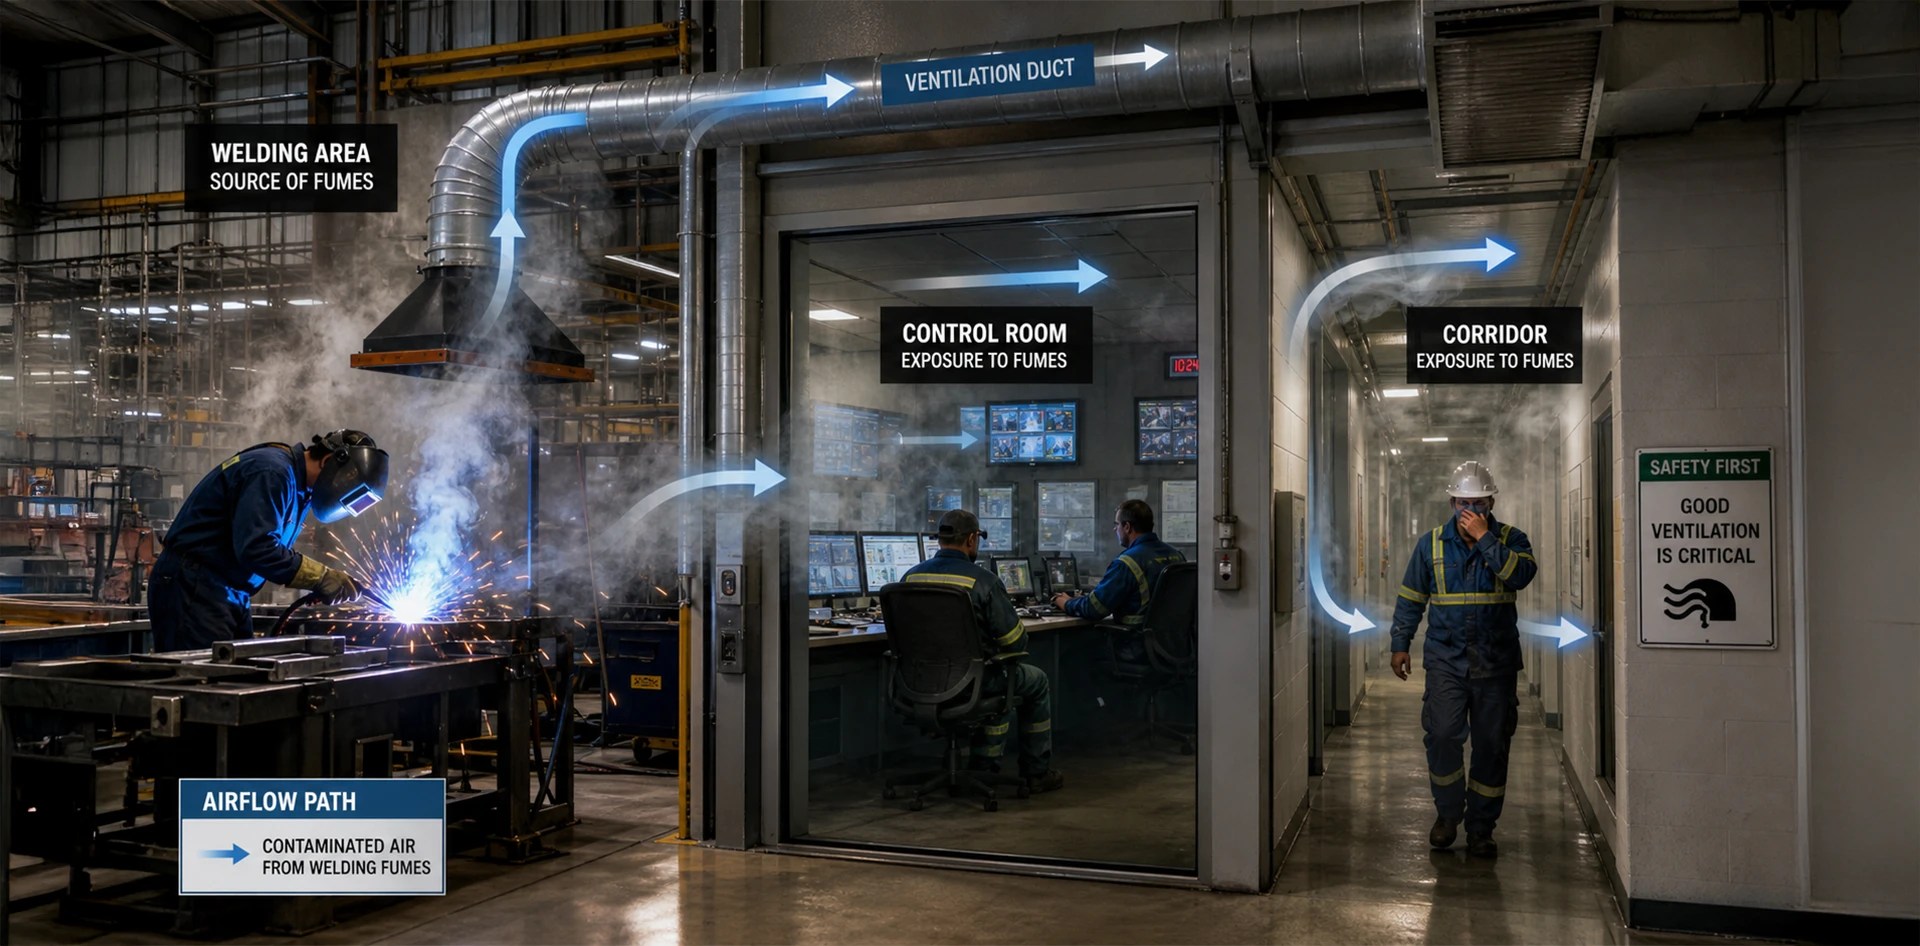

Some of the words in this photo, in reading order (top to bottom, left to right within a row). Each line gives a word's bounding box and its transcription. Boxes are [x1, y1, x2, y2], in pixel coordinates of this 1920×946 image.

[1650, 459, 1711, 476] SAFETY
[1715, 458, 1761, 475] FIRST
[1680, 497, 1730, 515] GOOD
[1651, 522, 1760, 540] VENTILATION
[1657, 547, 1673, 564] IS
[1678, 547, 1756, 564] CRITICAL
